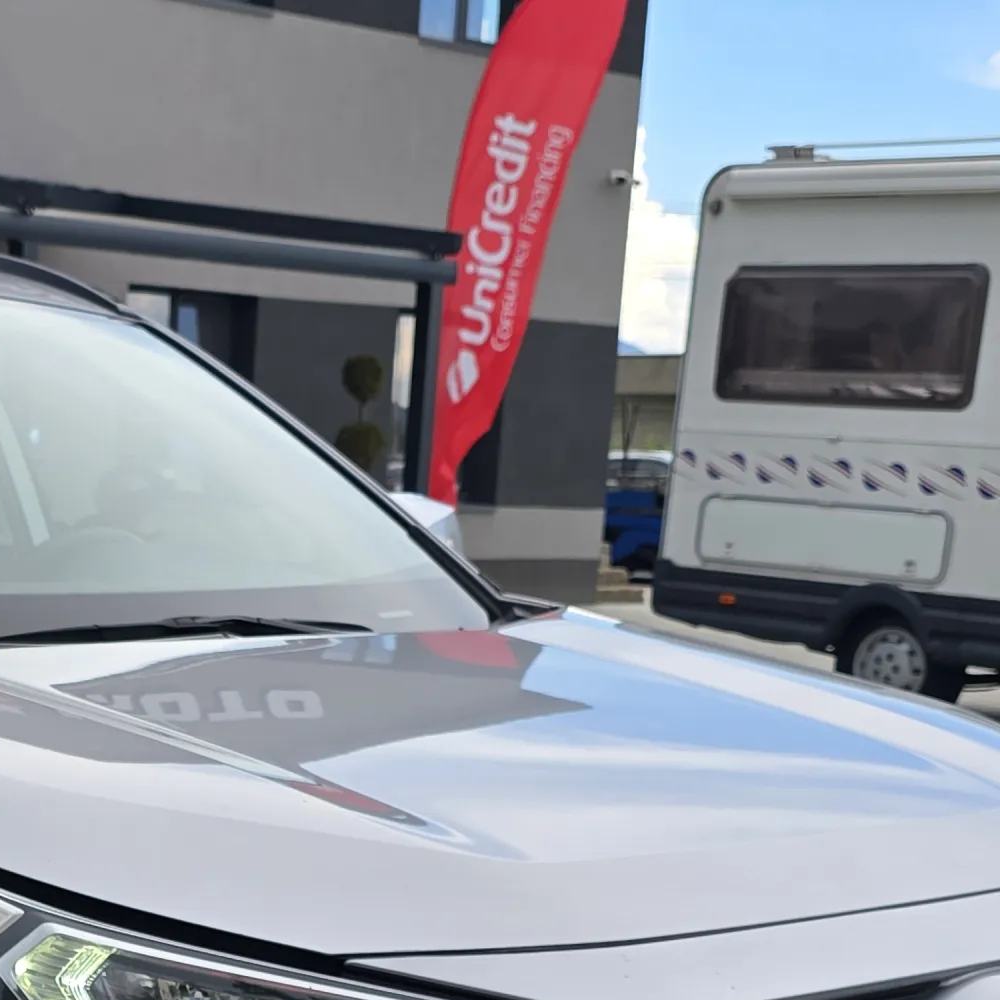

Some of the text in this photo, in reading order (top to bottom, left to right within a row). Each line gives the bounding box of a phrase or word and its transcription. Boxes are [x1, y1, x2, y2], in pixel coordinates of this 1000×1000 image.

[458, 112, 537, 346] UniCredit
[490, 123, 575, 352] Consumer Financing
